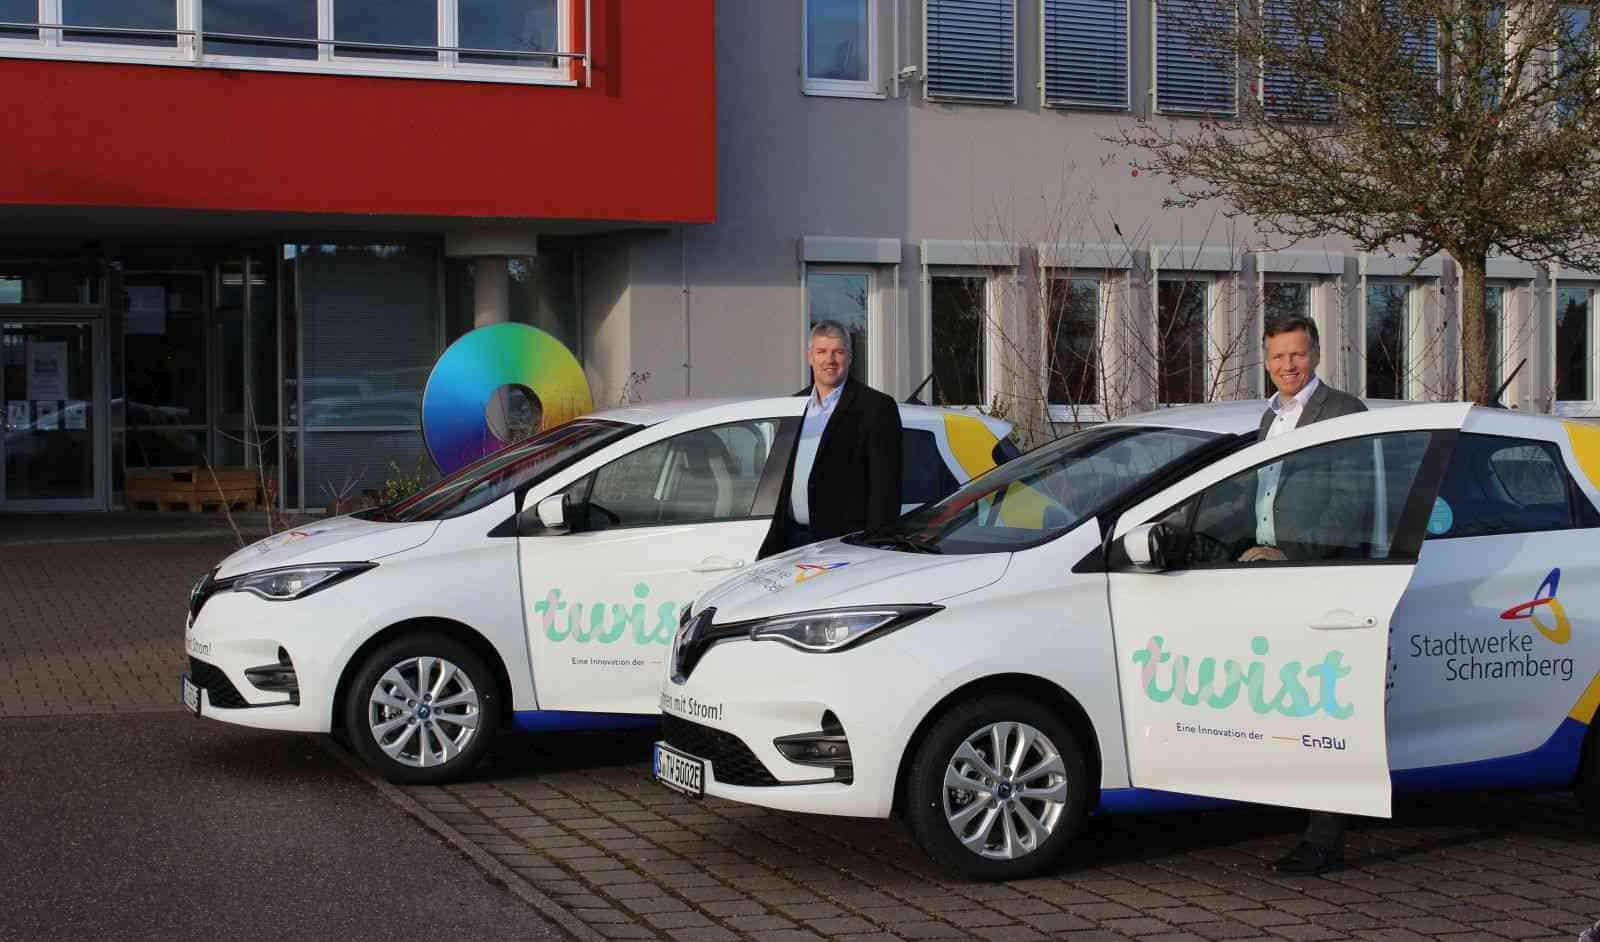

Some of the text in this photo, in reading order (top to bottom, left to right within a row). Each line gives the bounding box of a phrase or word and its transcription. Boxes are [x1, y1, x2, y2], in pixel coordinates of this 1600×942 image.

[534, 582, 678, 645] twis
[1409, 629, 1534, 658] Stadtwerke
[571, 656, 645, 667] Eine Innovation der
[1446, 654, 1574, 682] Schramberg
[1132, 635, 1355, 721] twist
[688, 696, 723, 721] Strom!
[1175, 722, 1347, 751] Eine Innovation der EnBW
